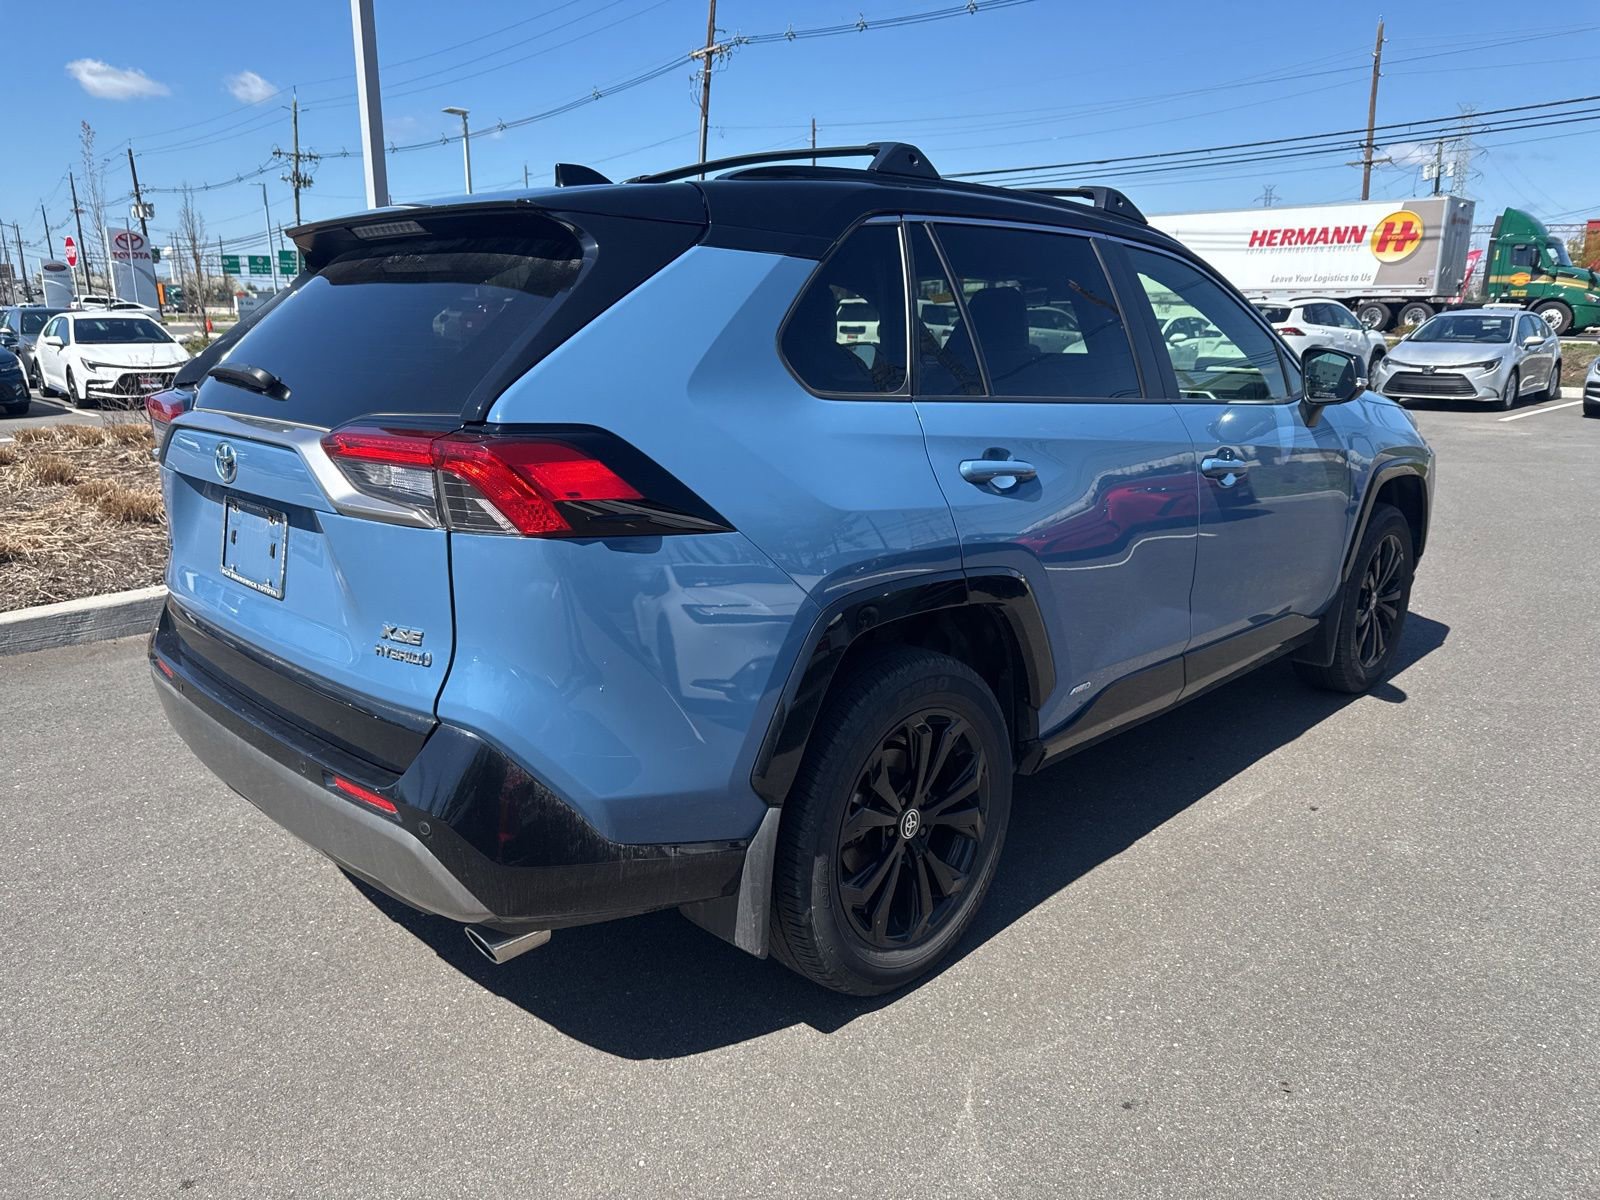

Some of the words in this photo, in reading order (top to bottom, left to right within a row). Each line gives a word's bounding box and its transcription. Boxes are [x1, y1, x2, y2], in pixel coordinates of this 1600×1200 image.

[1248, 225, 1367, 248] HERMANN
[1270, 246, 1325, 255] DISTRIBUTION
[1328, 244, 1361, 253] SERVICE
[112, 251, 151, 260] TOYOTA
[1270, 274, 1293, 283] Leave
[1295, 274, 1312, 283] Your
[1313, 273, 1349, 284] Logistics
[1350, 273, 1358, 282] to
[1360, 273, 1372, 282] Us
[257, 584, 278, 596] TOYOTA
[375, 644, 432, 668] HYBRID
